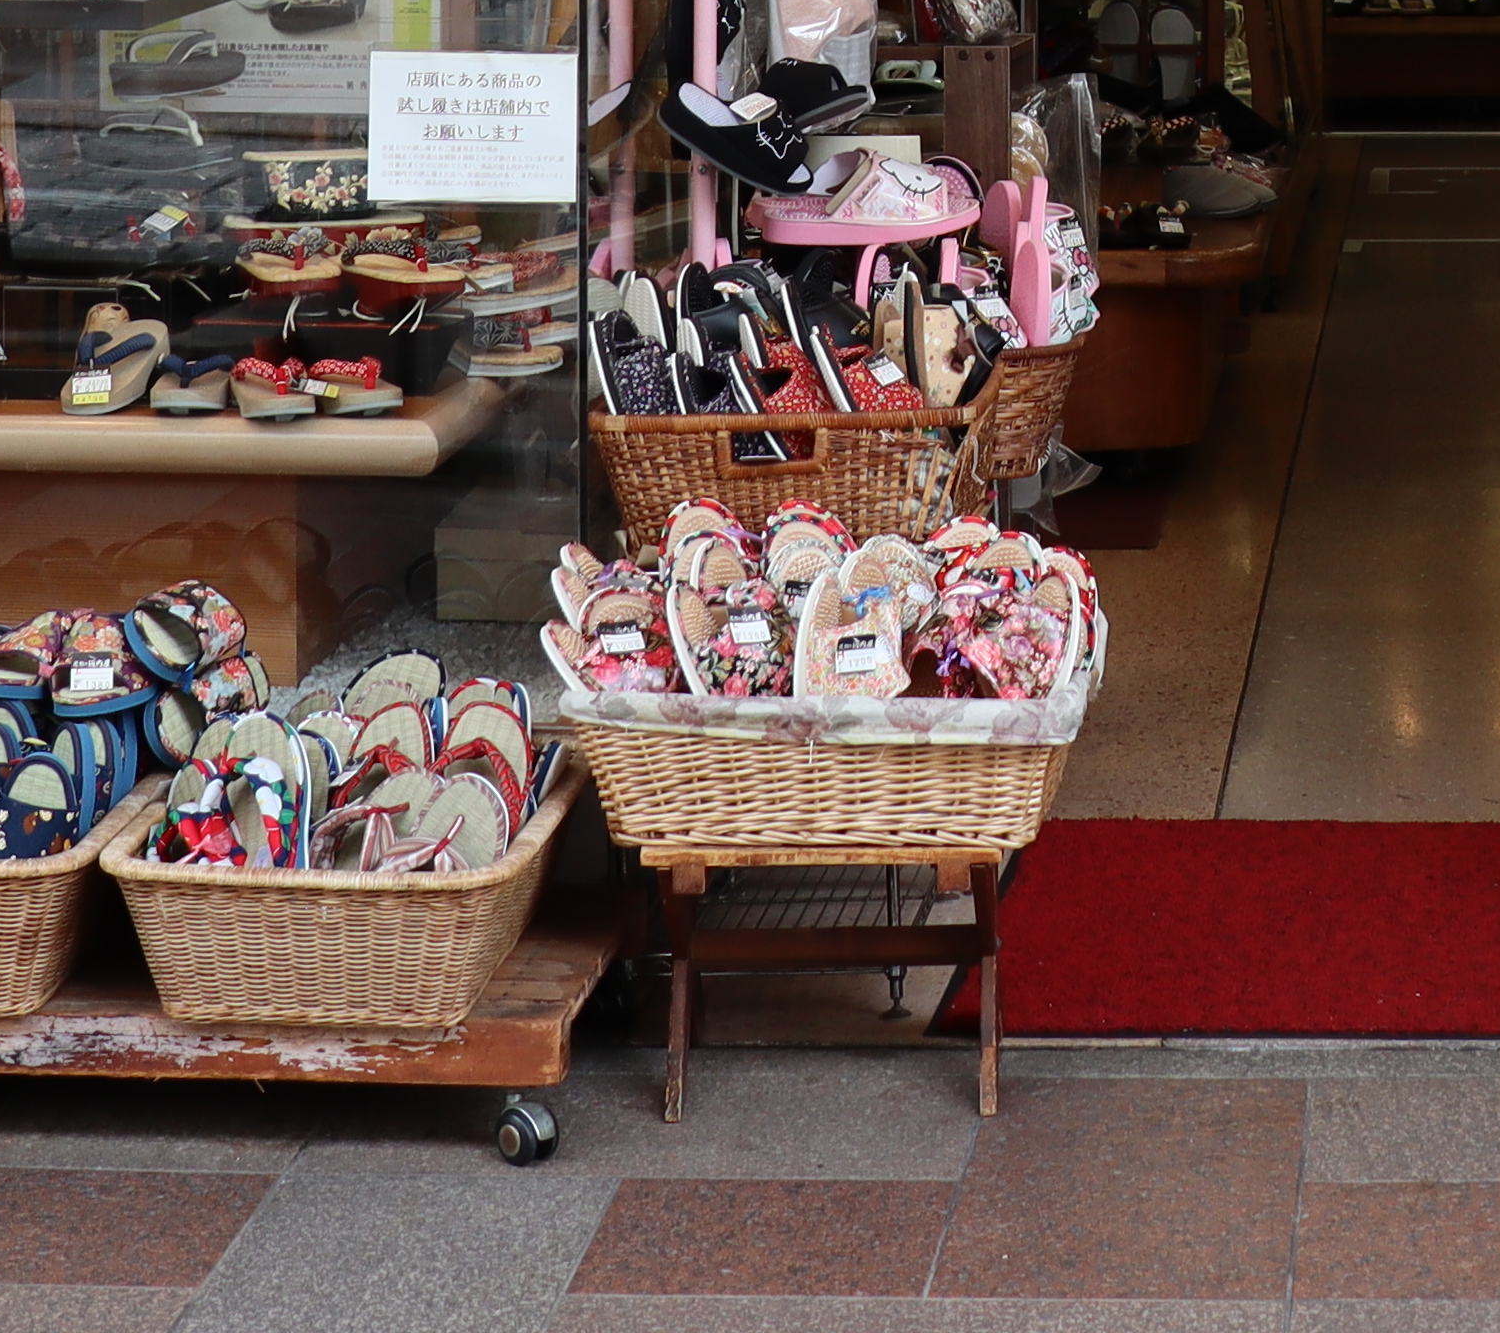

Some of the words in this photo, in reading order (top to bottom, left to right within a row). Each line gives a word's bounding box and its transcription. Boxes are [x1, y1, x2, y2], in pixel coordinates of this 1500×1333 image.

[406, 71, 542, 89] 店頭にある商品の
[396, 97, 550, 114] 試し履きは店舗内で
[423, 123, 524, 140] お願いします
